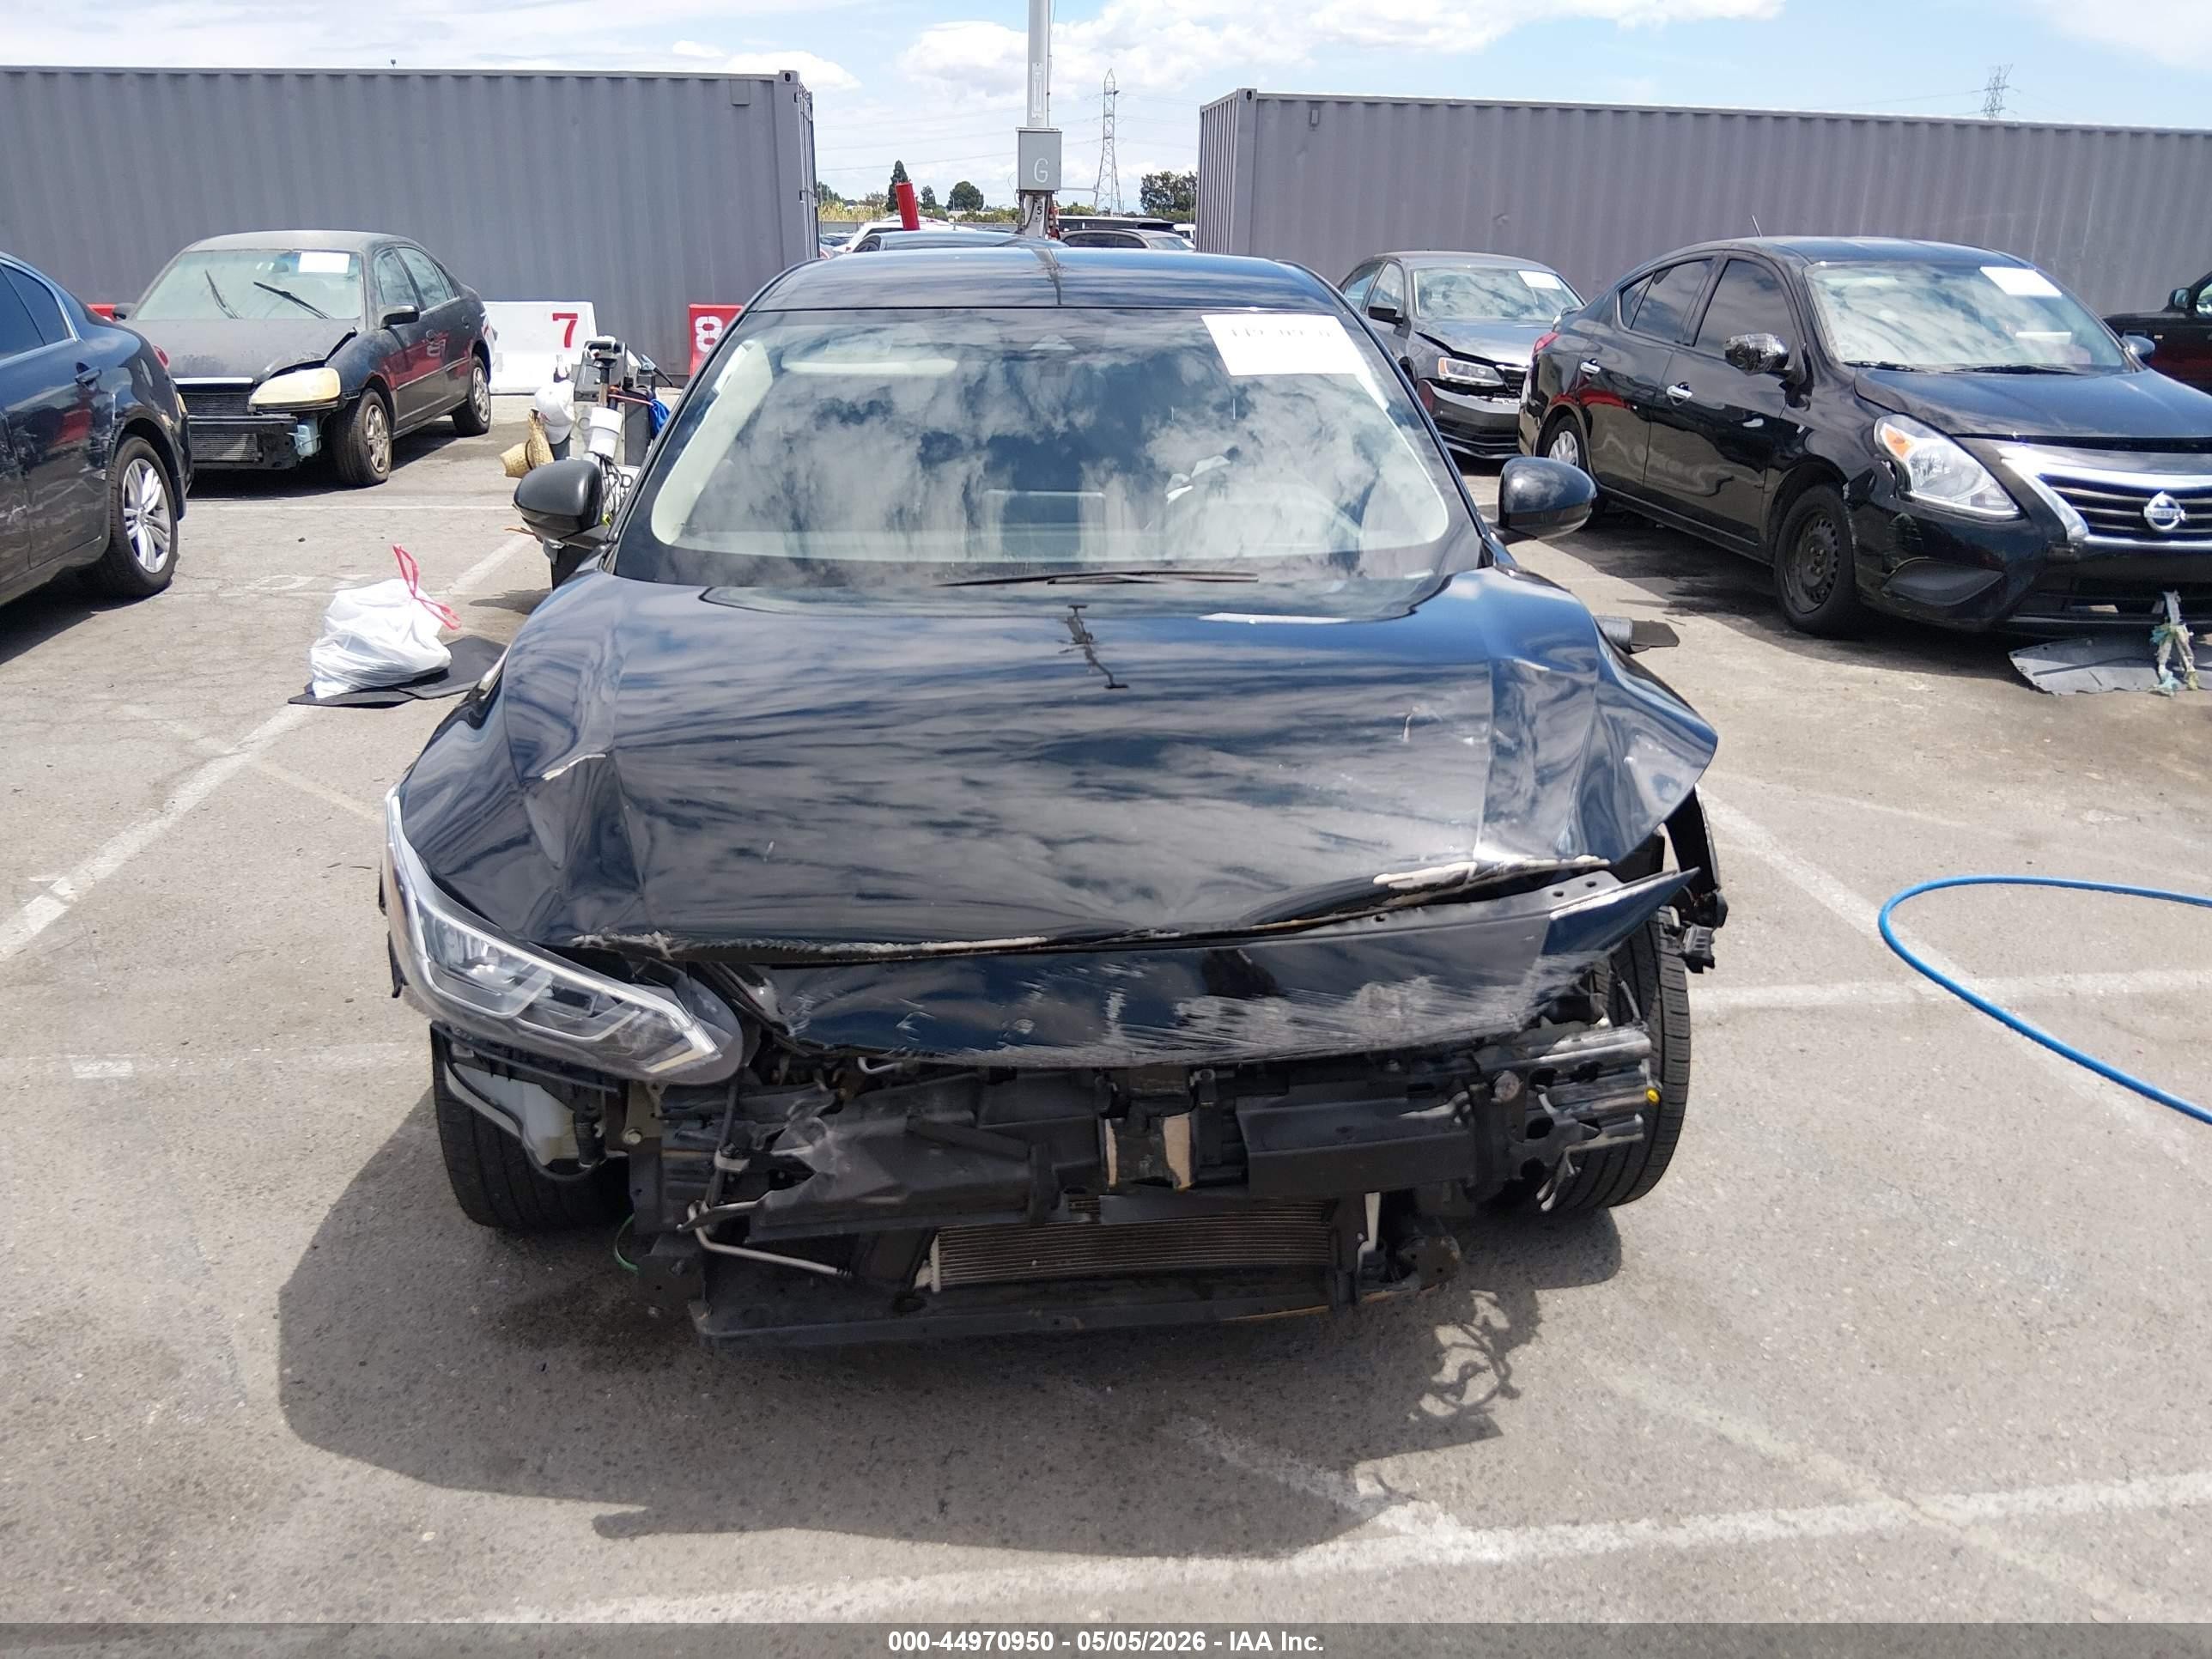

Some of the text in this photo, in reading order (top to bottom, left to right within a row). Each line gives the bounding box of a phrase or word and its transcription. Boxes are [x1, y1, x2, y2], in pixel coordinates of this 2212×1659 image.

[1034, 158, 1048, 183] G
[1036, 205, 1042, 216] 5
[552, 313, 578, 348] 7
[695, 315, 723, 353] 8
